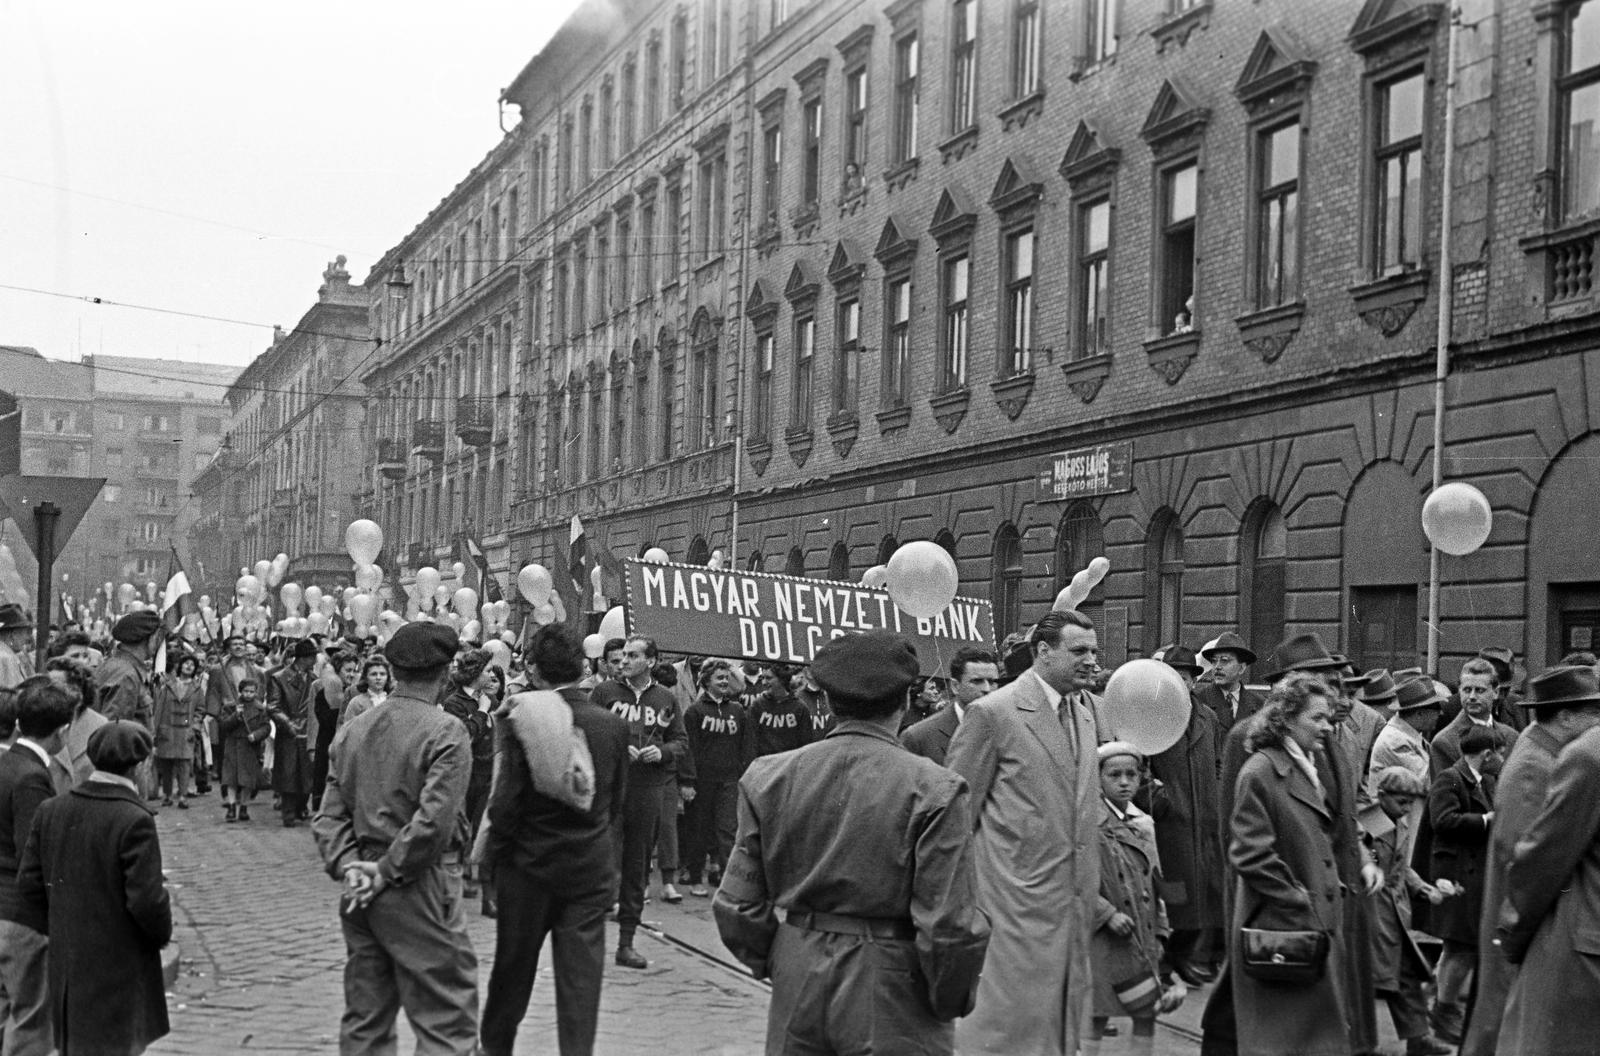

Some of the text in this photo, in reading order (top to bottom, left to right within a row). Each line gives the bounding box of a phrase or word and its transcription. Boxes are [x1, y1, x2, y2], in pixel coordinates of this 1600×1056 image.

[642, 566, 761, 618] MAGYAR
[773, 582, 901, 633] NEMZETI
[739, 617, 865, 662] DOLG
[701, 715, 738, 735] MNB
[759, 711, 798, 729] MNB
